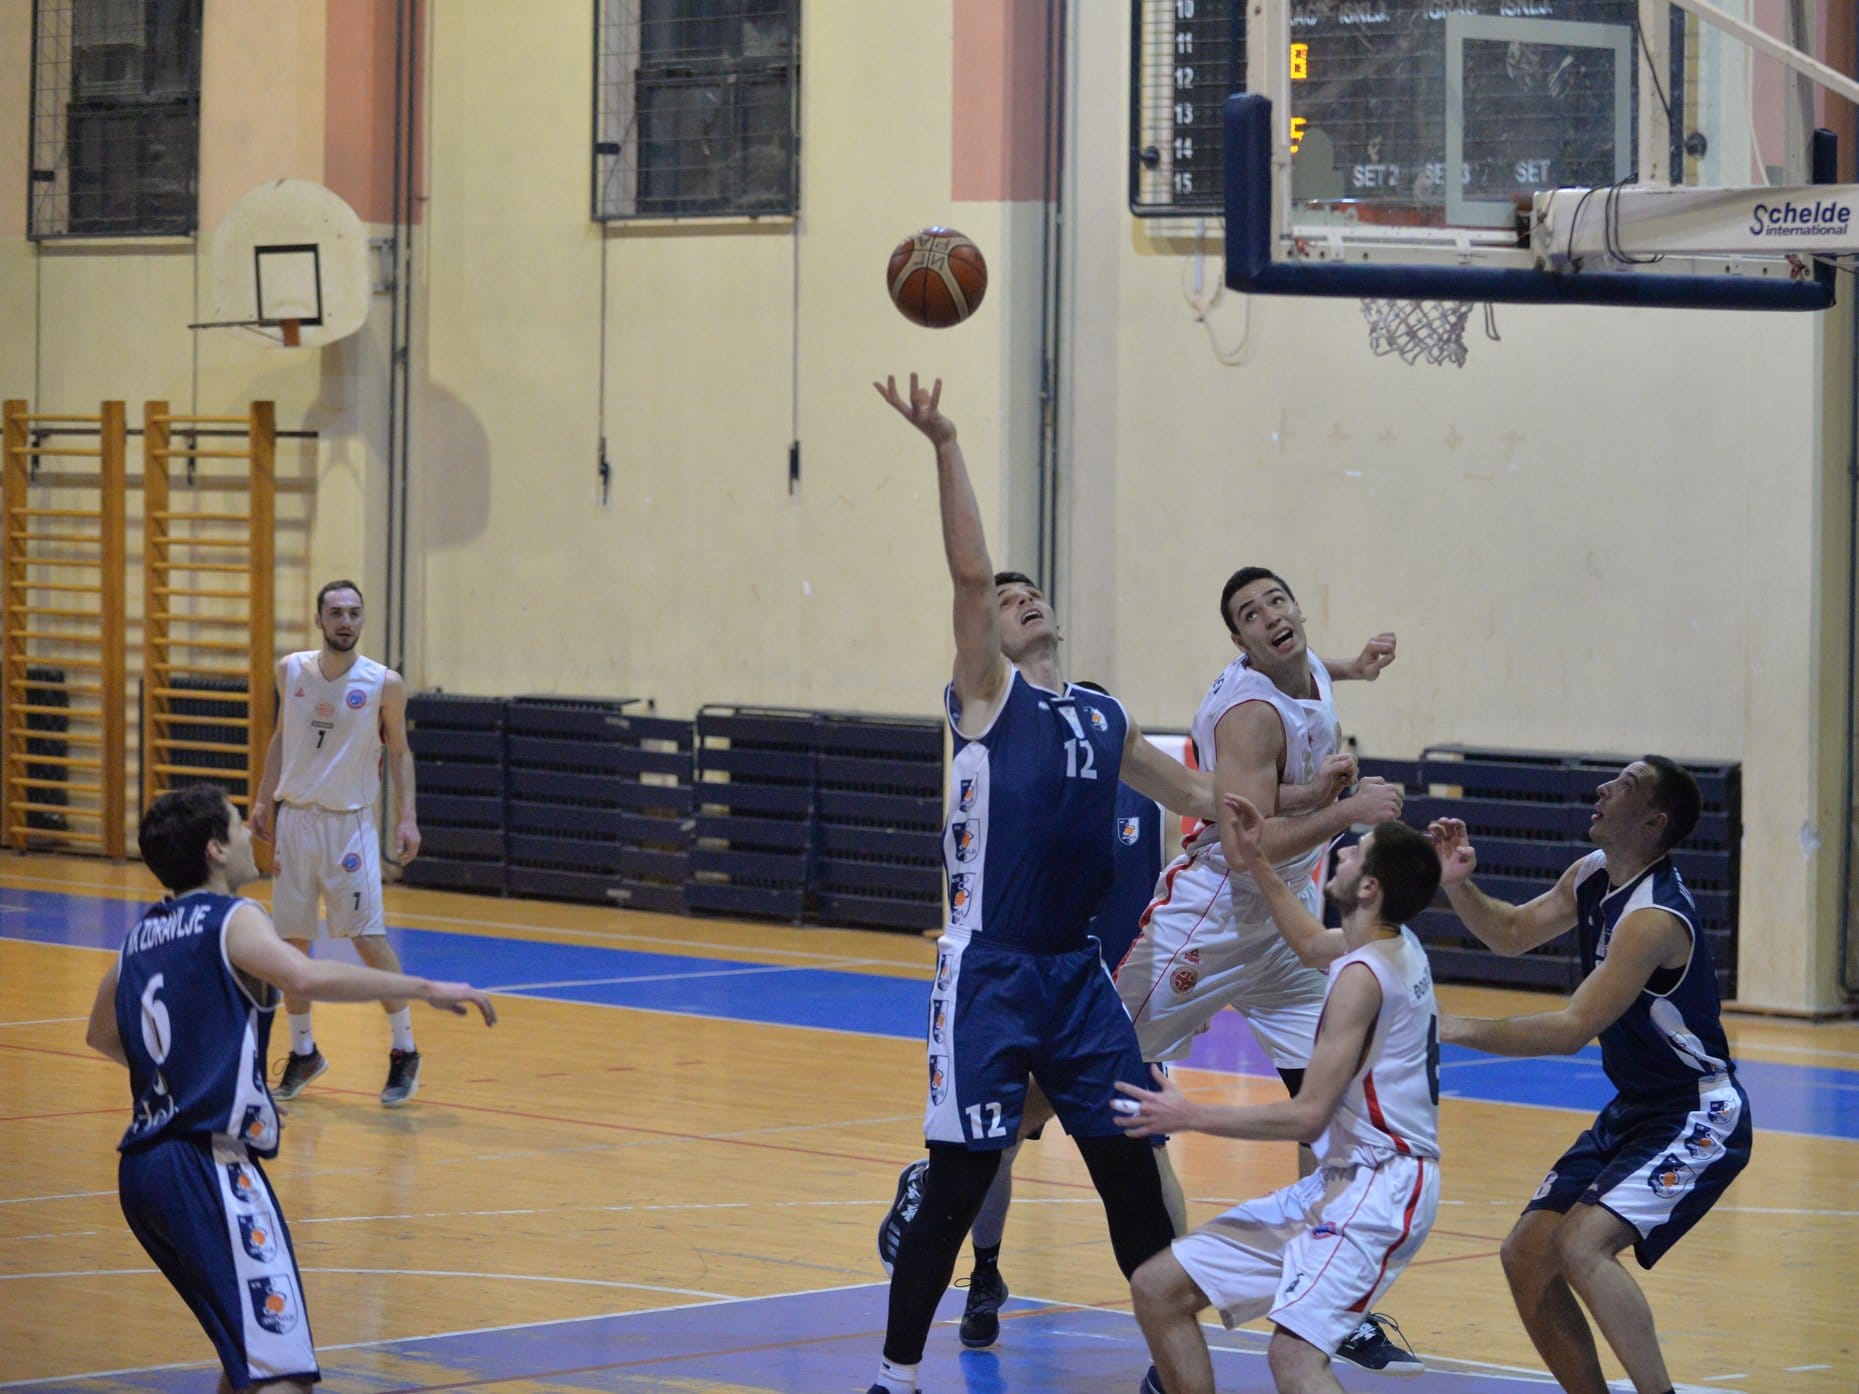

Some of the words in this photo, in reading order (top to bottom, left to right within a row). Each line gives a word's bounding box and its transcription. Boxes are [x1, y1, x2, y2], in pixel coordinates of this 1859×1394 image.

[1175, 0, 1195, 19] 10
[1175, 32, 1193, 54] 11
[1174, 66, 1194, 89] 12
[1174, 102, 1194, 124] 13
[1174, 137, 1193, 160] 14
[1352, 163, 1385, 188] SET
[1425, 162, 1450, 185] SE
[1515, 159, 1551, 184] SET
[1174, 173, 1193, 195] 15
[1749, 201, 1851, 236] Schelde
[1765, 223, 1848, 236] international
[1063, 737, 1098, 780] 12
[140, 972, 173, 1066] 6
[964, 1101, 1008, 1140] 12
